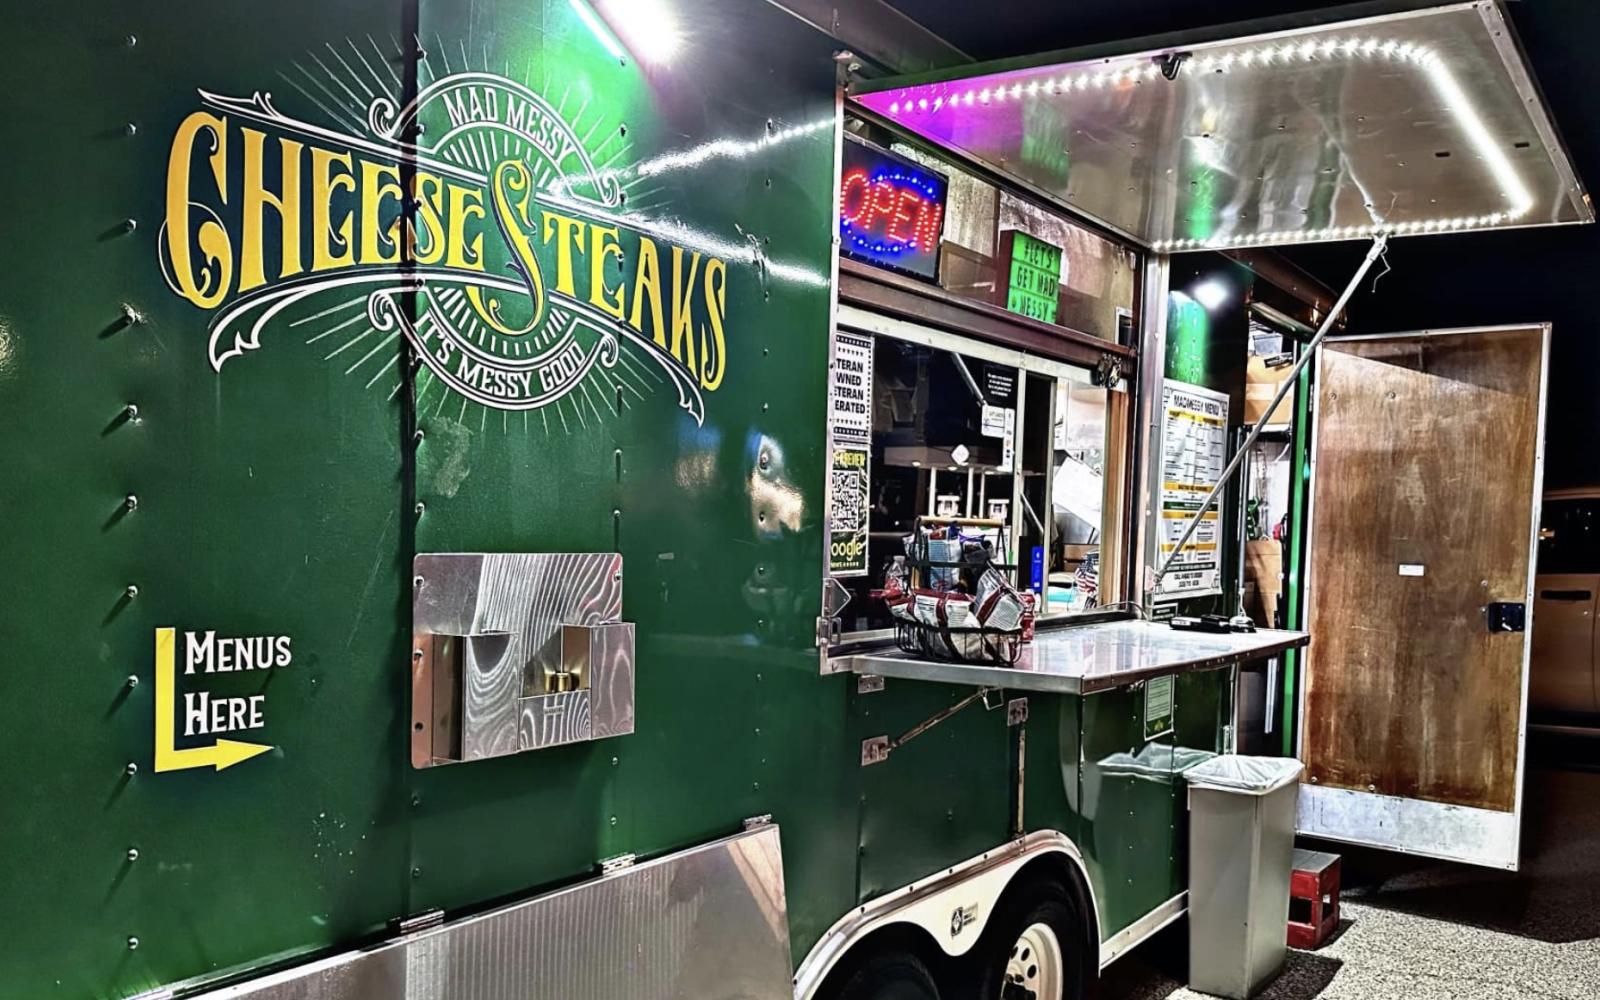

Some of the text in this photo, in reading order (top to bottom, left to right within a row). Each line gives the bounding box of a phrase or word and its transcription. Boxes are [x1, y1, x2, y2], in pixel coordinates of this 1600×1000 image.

[441, 86, 577, 168] MAD MESSY
[840, 172, 942, 253] OPEN
[1017, 265, 1056, 297] GET MAD
[412, 309, 586, 398] IT'S MESSY GOOD
[836, 358, 864, 373] TERAN
[834, 385, 864, 401] ETERAN
[836, 371, 862, 386] WNED
[834, 399, 866, 414] ERATED
[831, 541, 863, 562] oogle
[184, 630, 292, 675] MENUS
[183, 691, 265, 736] HERE
